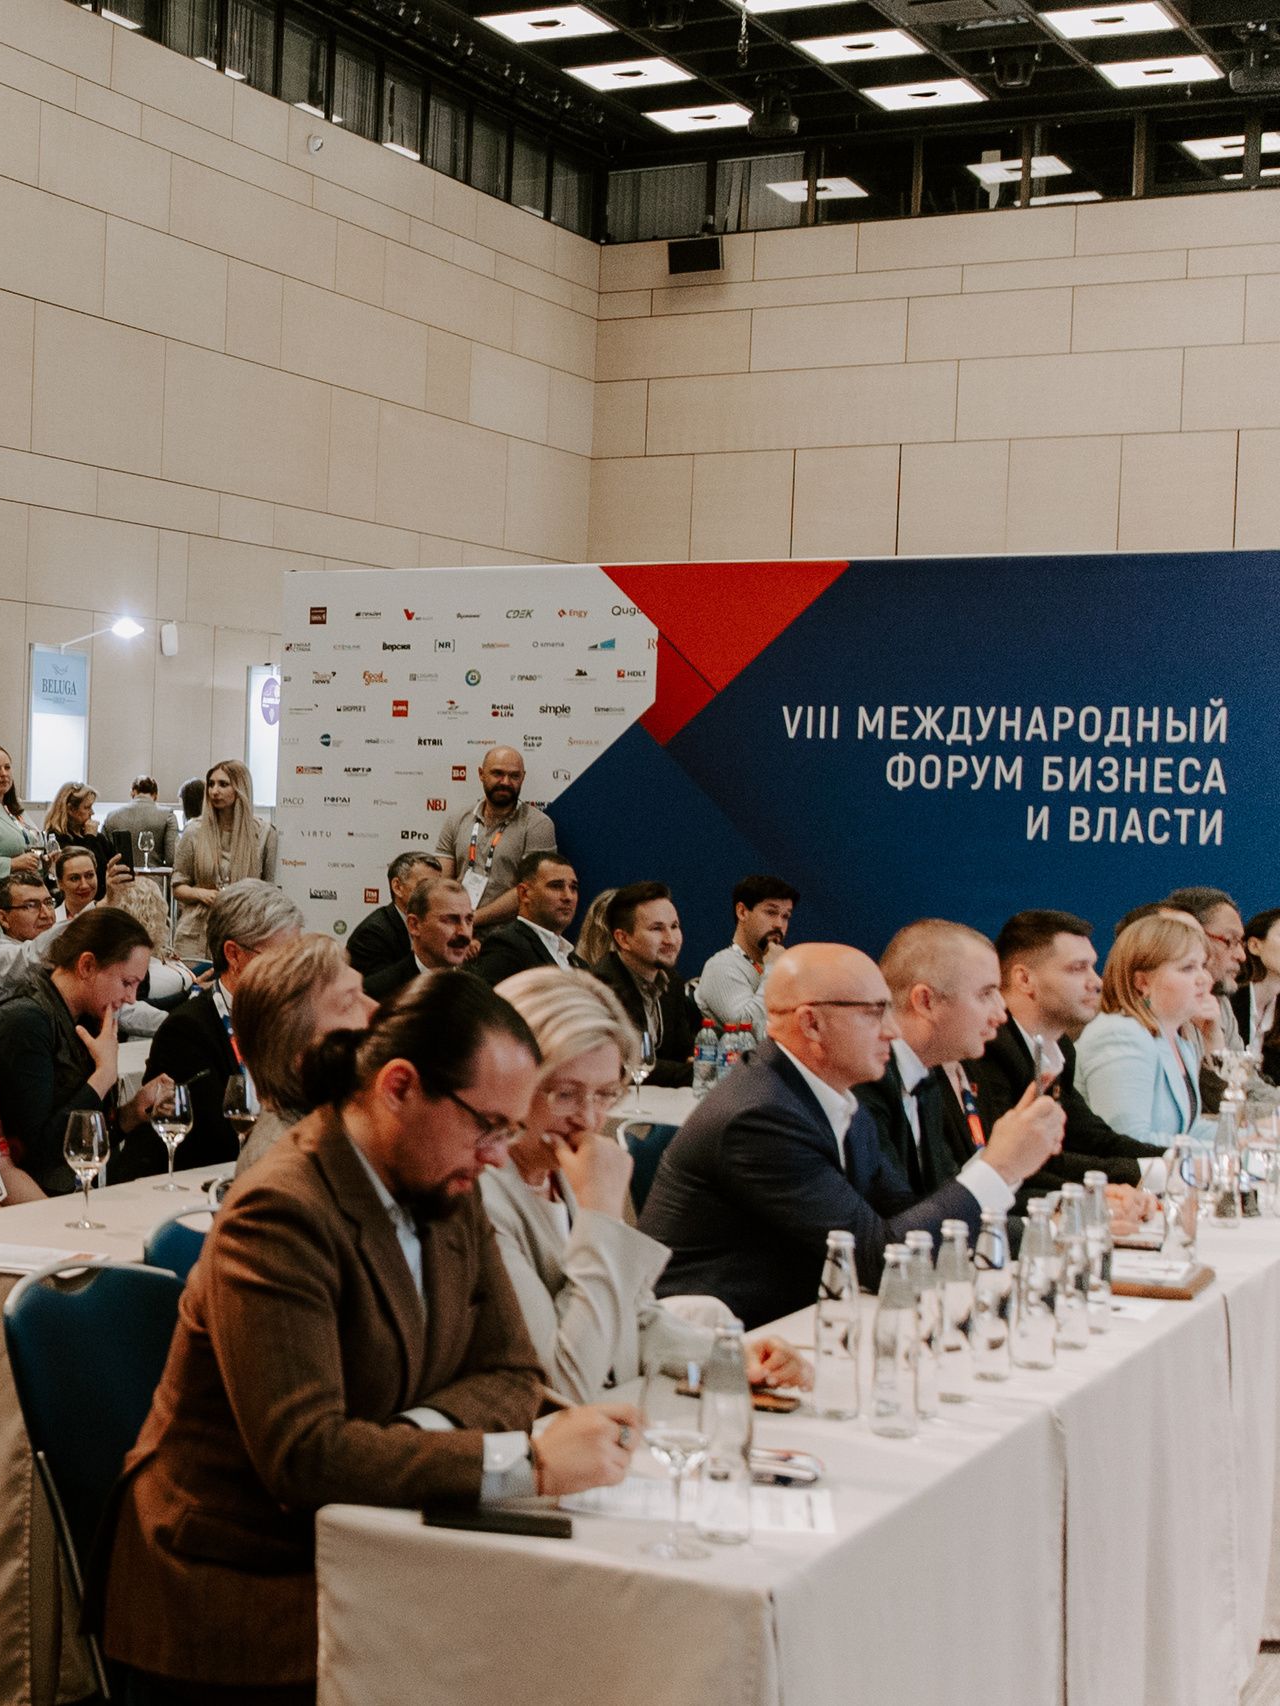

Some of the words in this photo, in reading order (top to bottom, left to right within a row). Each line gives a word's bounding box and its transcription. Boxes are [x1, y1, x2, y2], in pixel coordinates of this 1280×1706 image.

[569, 609, 588, 618] Engy
[382, 642, 411, 652] Версия
[647, 638, 658, 650] R
[42, 679, 77, 695] BELUGA
[539, 703, 571, 716] simple
[782, 706, 839, 739] VIII
[857, 697, 1228, 747] МЕЖДУНАРОДНЫЙ
[885, 752, 1023, 791] ФОРУМ
[1041, 755, 1227, 795] БИЗНЕСА
[427, 799, 447, 811] NBJ
[1026, 805, 1049, 841] И
[1069, 806, 1224, 845] ВЛАСТИ
[410, 831, 429, 840] Pro
